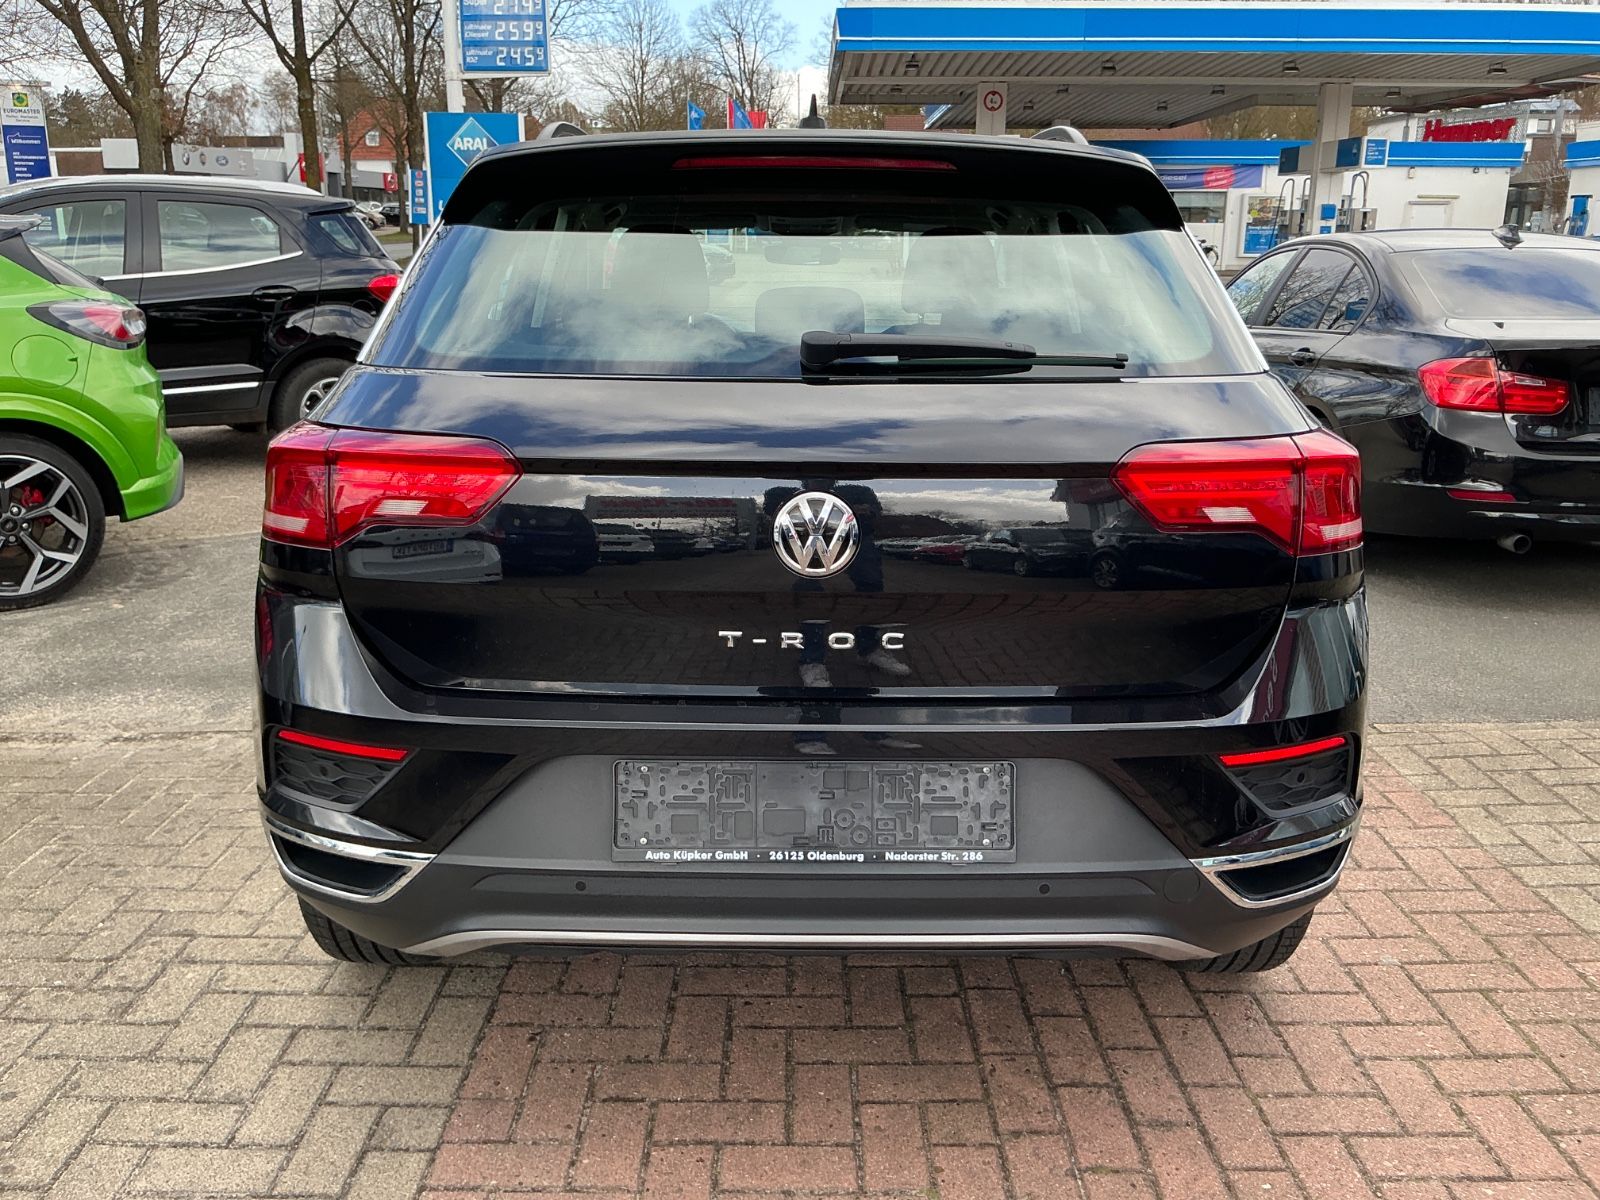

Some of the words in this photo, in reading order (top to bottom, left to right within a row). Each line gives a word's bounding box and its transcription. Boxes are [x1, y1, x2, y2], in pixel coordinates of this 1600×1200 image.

[645, 851, 670, 860] Auto
[673, 850, 711, 862] Küpker
[715, 850, 748, 860] GmbH
[769, 851, 804, 860] 26125
[807, 851, 864, 862] Oldenburg
[885, 851, 939, 861] Nadorster
[941, 851, 959, 861] Str.
[962, 851, 983, 861] 286
